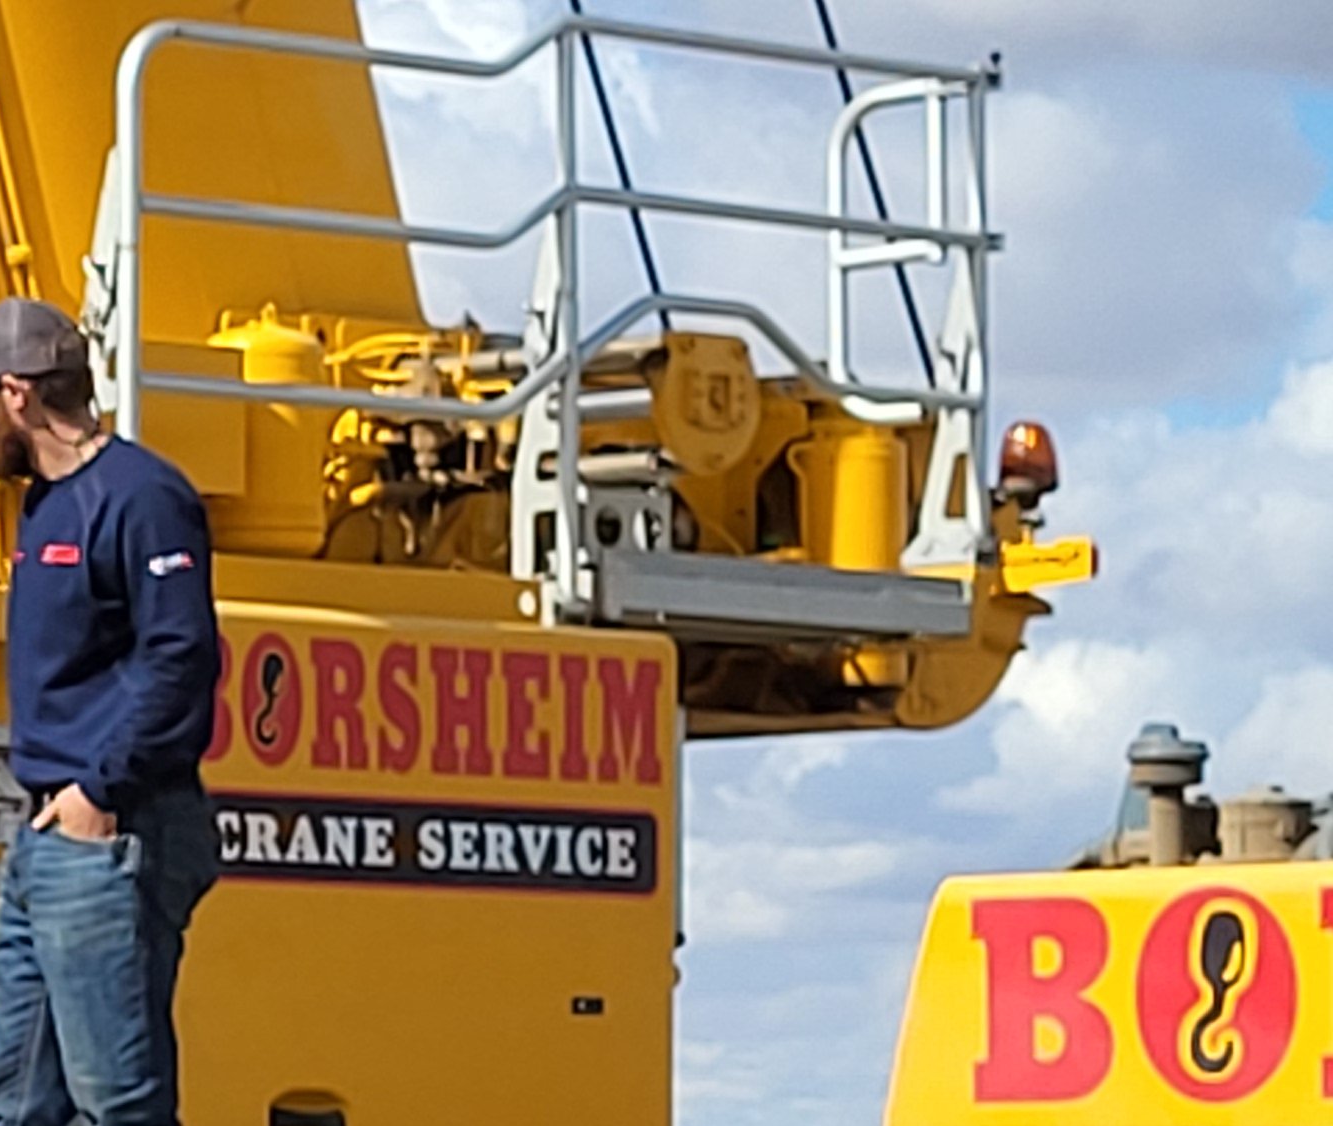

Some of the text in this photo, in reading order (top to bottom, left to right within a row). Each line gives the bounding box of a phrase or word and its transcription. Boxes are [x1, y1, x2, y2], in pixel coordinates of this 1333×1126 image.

[216, 811, 637, 878] CRANE SERVICE
[970, 885, 1333, 1104] BO
